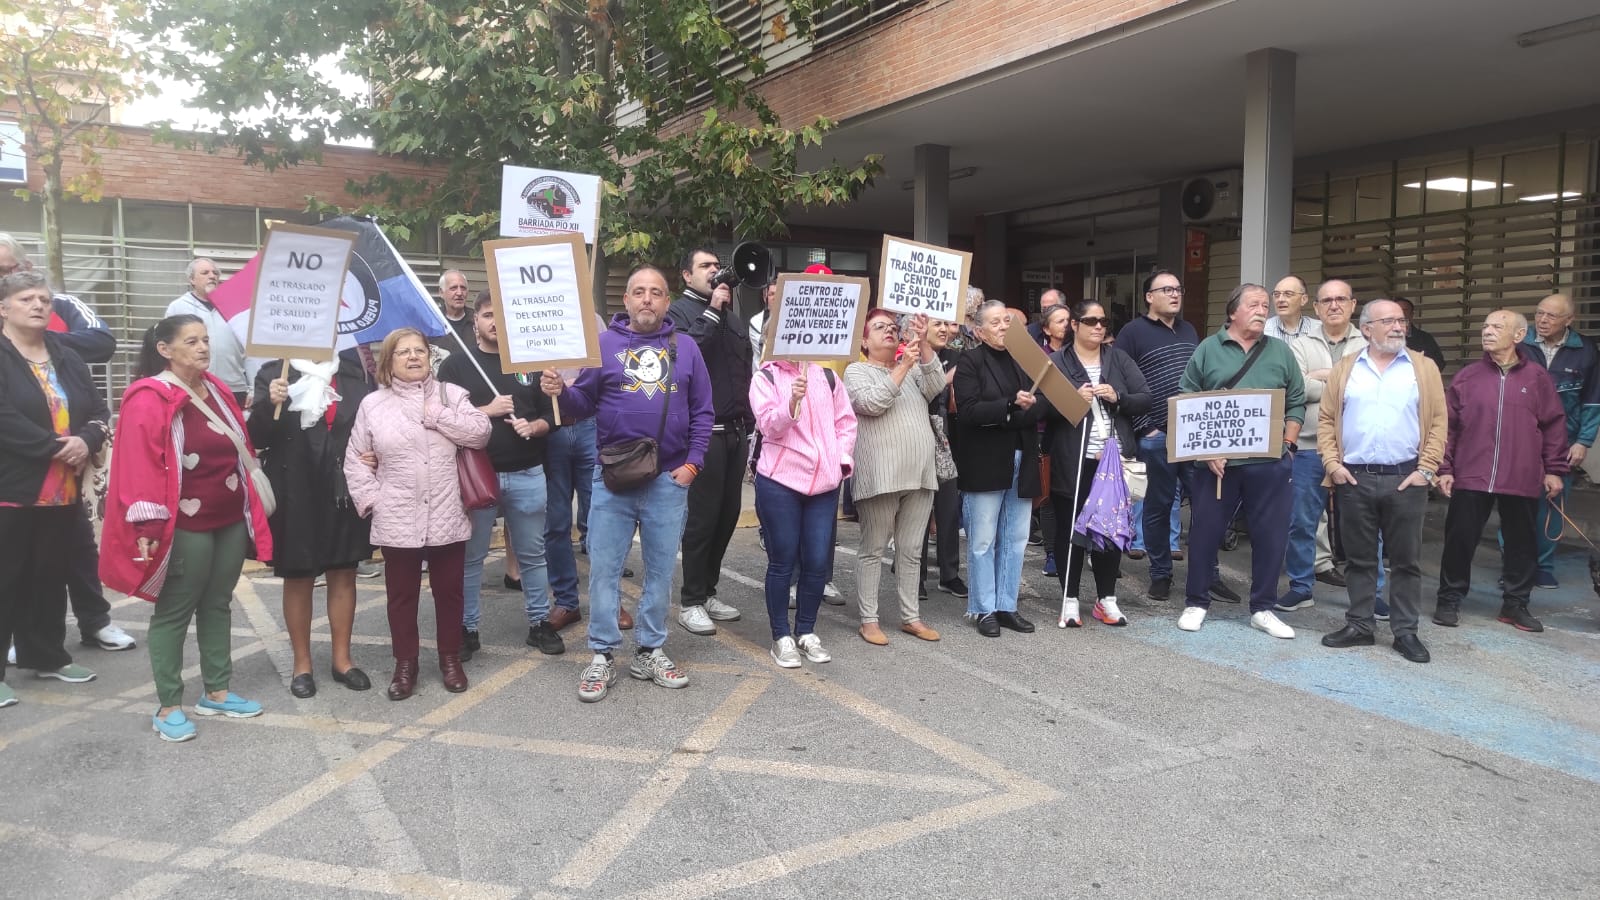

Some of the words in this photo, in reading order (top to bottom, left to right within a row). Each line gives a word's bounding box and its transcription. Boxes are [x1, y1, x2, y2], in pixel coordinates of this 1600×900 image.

[519, 218, 554, 228] BARRIADA
[287, 251, 322, 270] NO
[911, 251, 924, 262] NO
[926, 254, 938, 265] AL
[520, 264, 553, 284] NO
[890, 258, 938, 276] TRASLADO
[941, 268, 957, 280] DEL
[904, 273, 940, 288] CENTRO
[282, 281, 326, 291] TRASLADO
[799, 286, 830, 296] CENTRO
[833, 287, 843, 296] DE
[894, 282, 906, 294] DE
[909, 285, 938, 299] SALUD
[942, 291, 947, 301] 1
[288, 296, 320, 304] CENTRO
[523, 295, 564, 304] TRASLADO
[785, 297, 811, 307] SALUD,
[814, 296, 855, 308] ATENCIÓN
[283, 309, 311, 318] SALUD
[532, 310, 564, 318] CENTRO
[789, 308, 838, 318] CONTINUADA
[842, 310, 848, 318] Y
[292, 324, 305, 332] XII)
[532, 324, 557, 332] SALUD
[785, 319, 805, 328] ZONA
[809, 319, 833, 328] VERDE
[836, 320, 848, 329] EN
[543, 338, 556, 346] XII)
[1205, 401, 1221, 410] NO
[1225, 400, 1239, 409] AL
[1181, 410, 1239, 423] TRASLADO
[1244, 408, 1266, 417] DEL
[1199, 419, 1245, 430] CENTRO
[1188, 432, 1202, 441] DE
[1205, 428, 1243, 439] SALUD
[1249, 428, 1255, 436] 1
